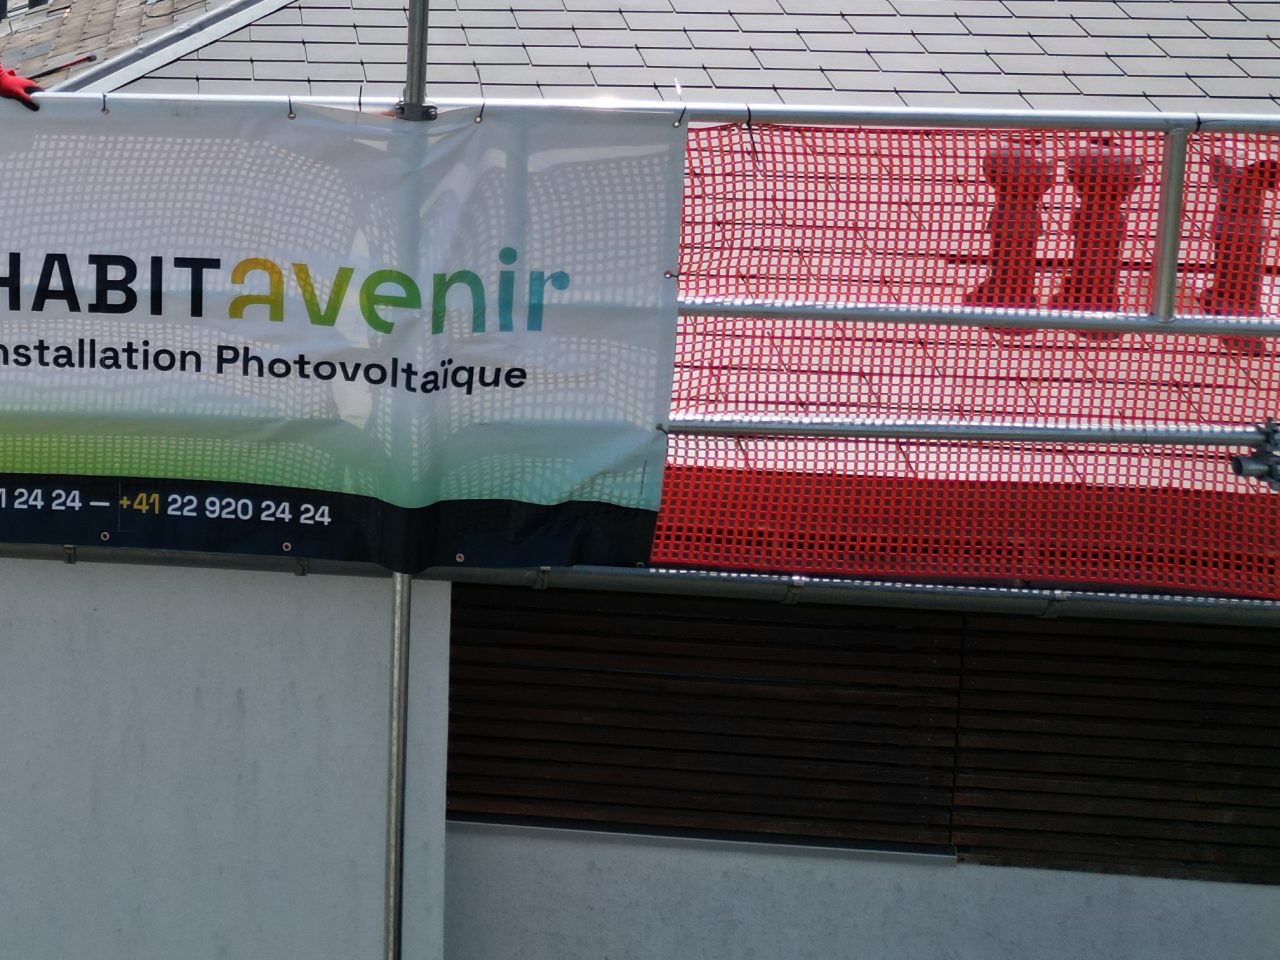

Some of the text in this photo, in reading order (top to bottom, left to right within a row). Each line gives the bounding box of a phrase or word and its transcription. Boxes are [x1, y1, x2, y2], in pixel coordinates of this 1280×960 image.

[216, 345, 529, 395] Photovoltaïque
[14, 488, 44, 510] 24
[51, 489, 82, 511] 24
[119, 493, 160, 515] +41
[167, 494, 197, 517] 22
[205, 497, 253, 520] 920
[261, 500, 292, 522] 24
[299, 504, 332, 525] 24
